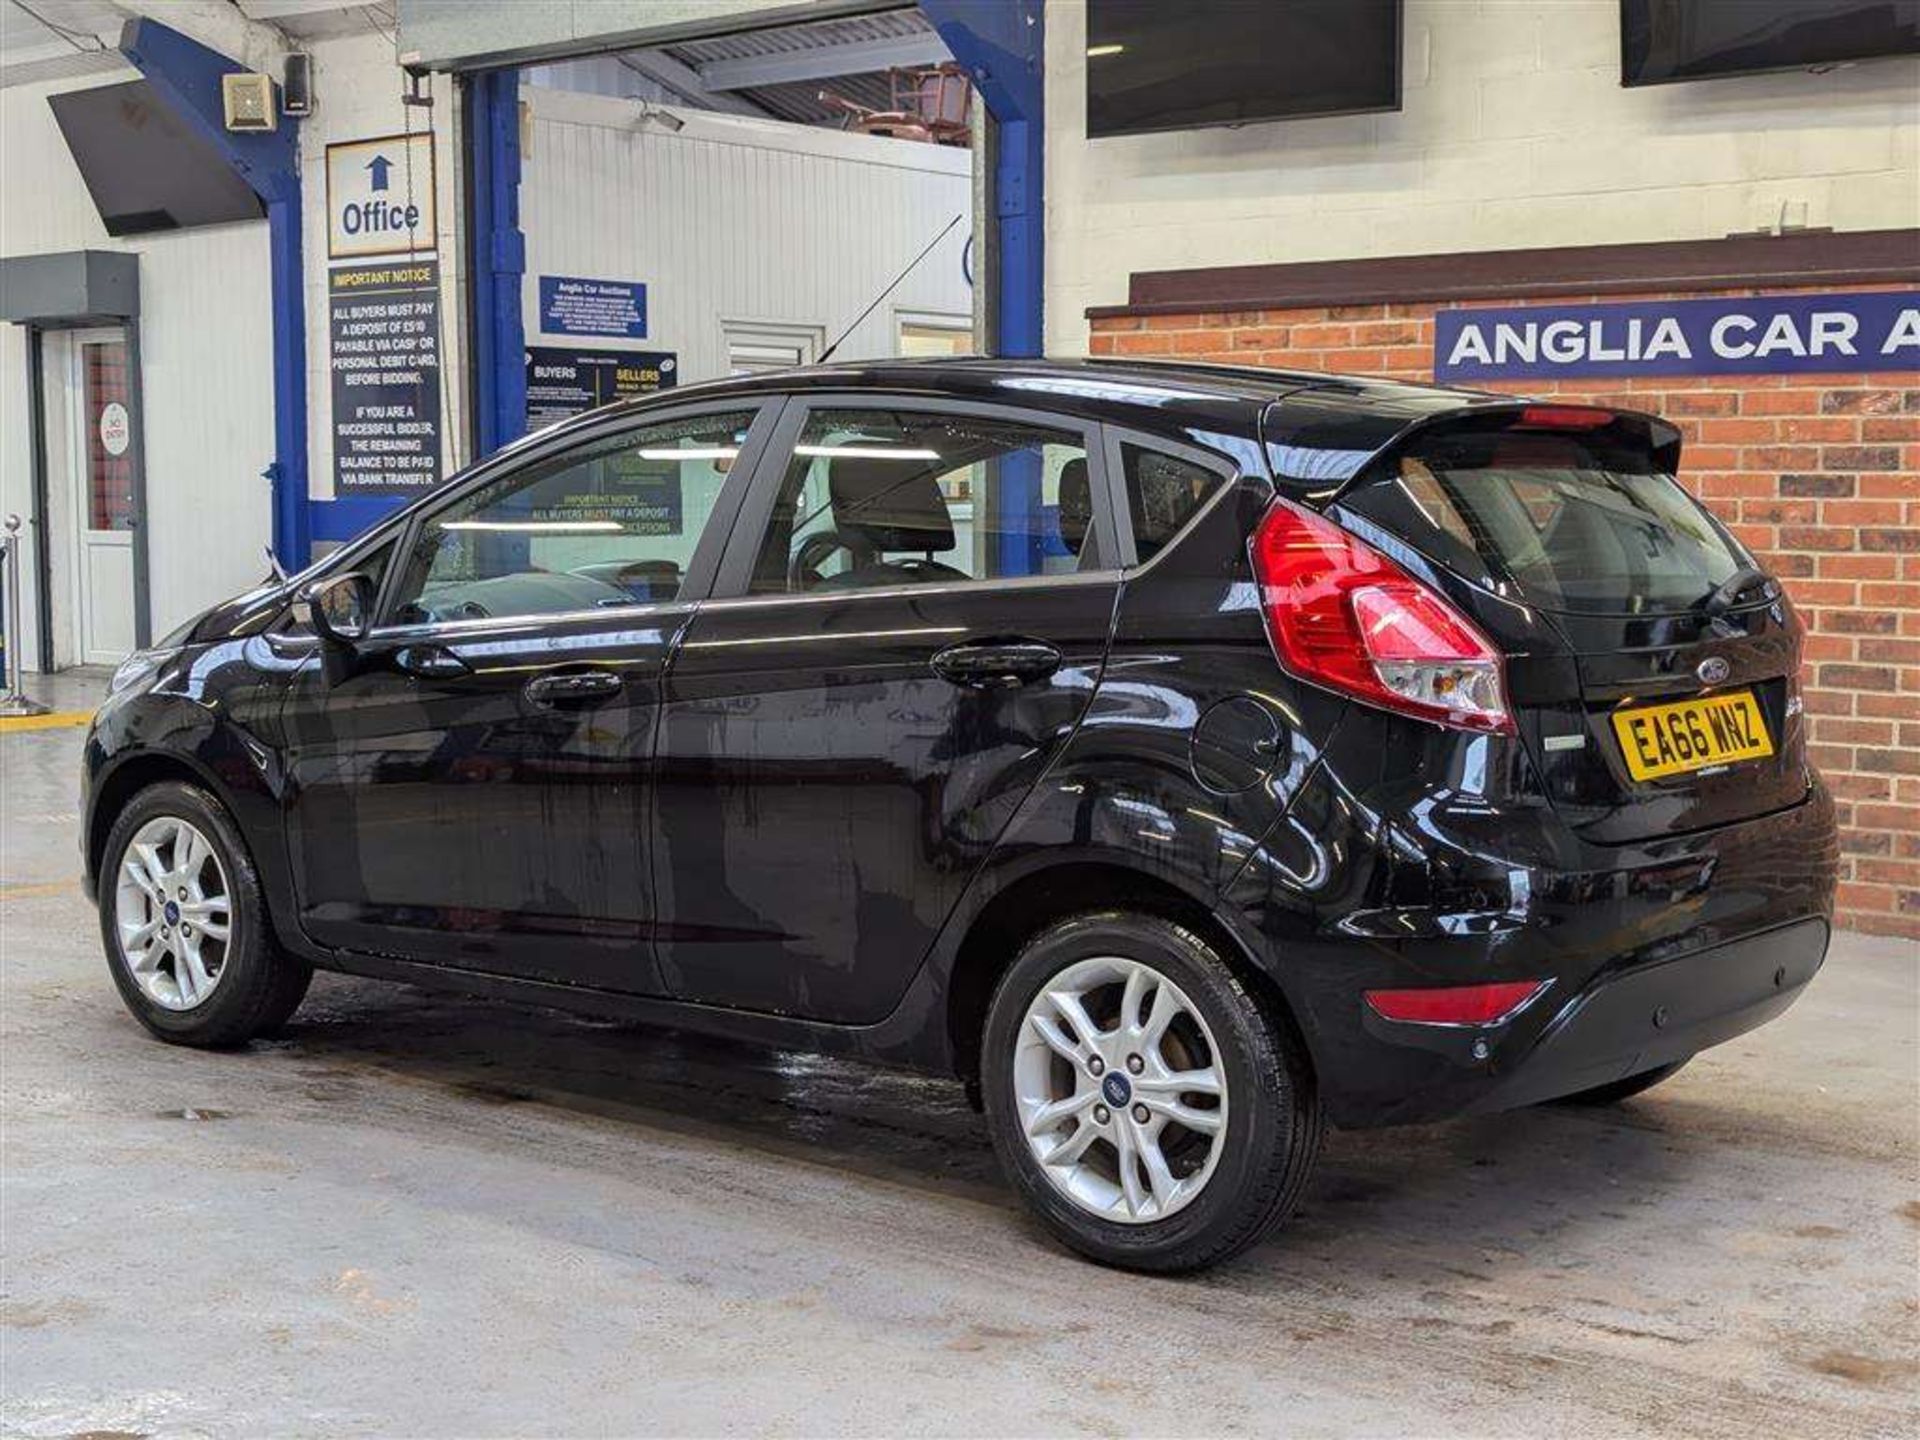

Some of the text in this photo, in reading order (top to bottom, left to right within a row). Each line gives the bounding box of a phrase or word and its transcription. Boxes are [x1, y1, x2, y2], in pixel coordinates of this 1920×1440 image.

[343, 201, 419, 234] Office
[334, 267, 431, 286] IMPORTANT NOTICE
[333, 302, 434, 320] ALL BUYERS MUST PAY
[342, 324, 349, 335] A
[350, 322, 388, 335] DEPOSIT
[389, 321, 402, 333] OF
[334, 340, 374, 352] PAYABLE
[376, 339, 391, 351] VIA
[420, 336, 434, 349] OR
[1448, 317, 1692, 365] ANGLIA
[1710, 312, 1858, 359] CAR
[333, 356, 379, 369] PERSONAL
[380, 355, 407, 367] DEBIT
[534, 365, 577, 379] BUYERS
[616, 368, 660, 382] SELLERS
[345, 373, 381, 386] BEFORE
[356, 406, 415, 418] IF YOU ARE A
[338, 423, 396, 435] SUCCESSFUL
[351, 439, 421, 451] THE REMAINING
[340, 456, 434, 468] BALANCE TO BE PAID
[341, 473, 357, 485] VIA
[357, 473, 384, 485] BANK
[1629, 701, 1760, 768] EA66 WNZ
